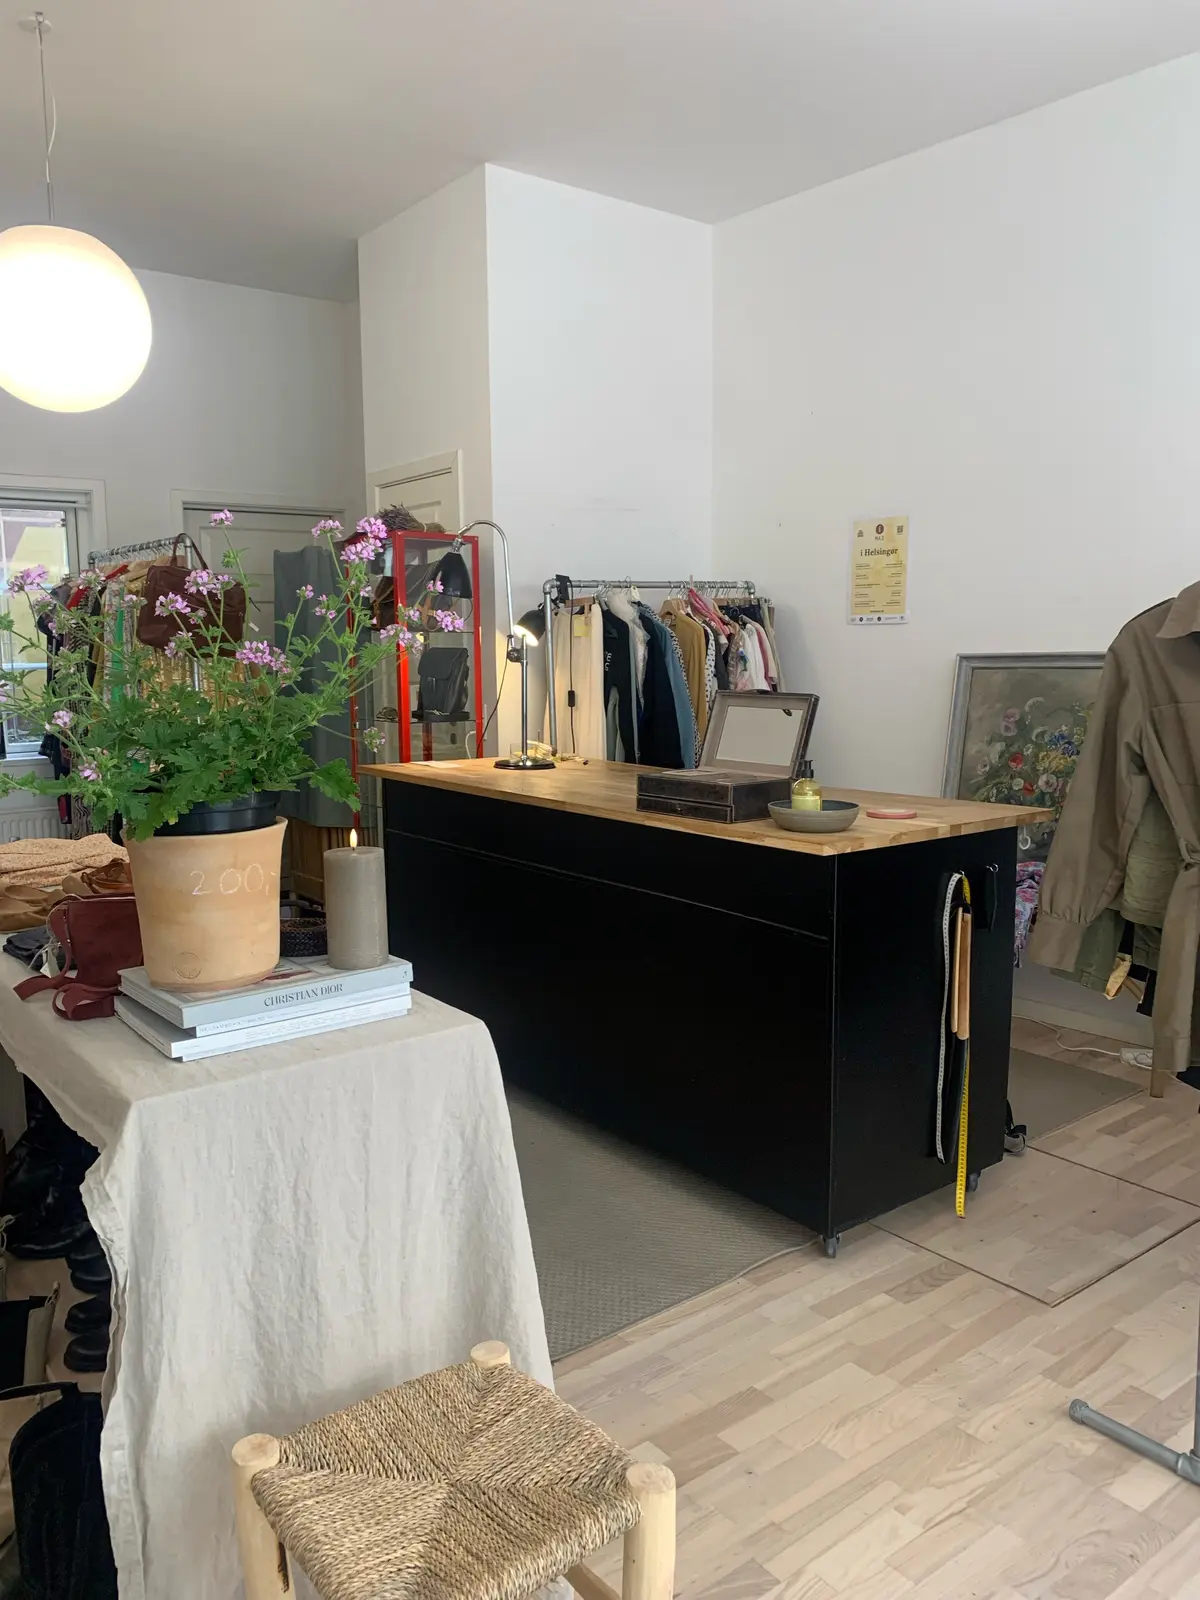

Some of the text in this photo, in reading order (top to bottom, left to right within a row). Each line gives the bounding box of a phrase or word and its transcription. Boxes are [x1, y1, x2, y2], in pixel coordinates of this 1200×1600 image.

[864, 547, 899, 557] Helsingør
[263, 983, 344, 1007] CHRISTIAN DIOR
